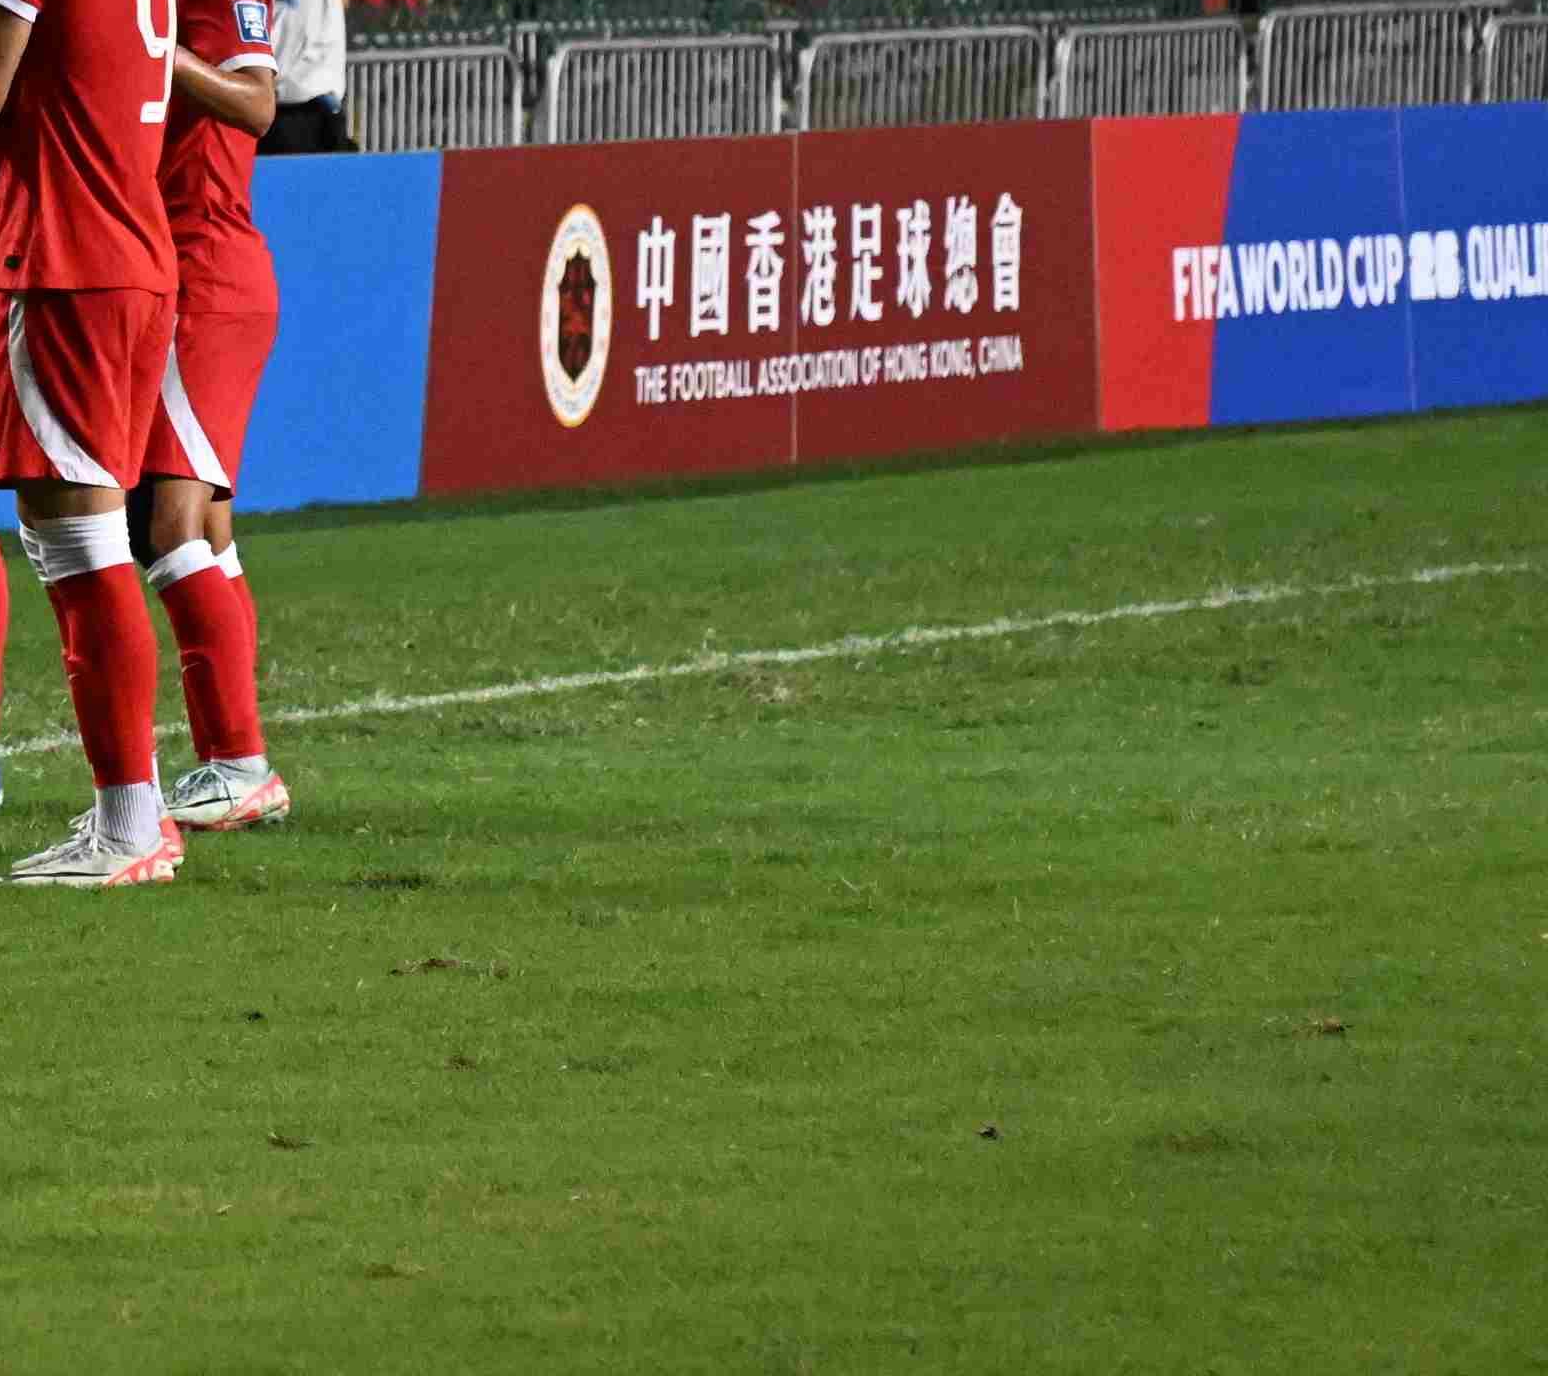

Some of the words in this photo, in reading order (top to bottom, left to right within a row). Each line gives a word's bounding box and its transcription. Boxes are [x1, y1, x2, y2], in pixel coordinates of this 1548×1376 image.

[635, 191, 1024, 343] 中國香港足球總會
[1172, 243, 1240, 323] FIFA
[1237, 237, 1345, 316] WORLD
[1346, 232, 1405, 309] CUP
[634, 362, 669, 408] THE
[670, 359, 754, 402] FOOTBALL
[757, 349, 857, 396] ASSOCIATION
[862, 346, 884, 386] OF
[884, 341, 928, 383] HONG
[930, 337, 977, 380] KONG,
[978, 333, 1024, 375] CHINA
